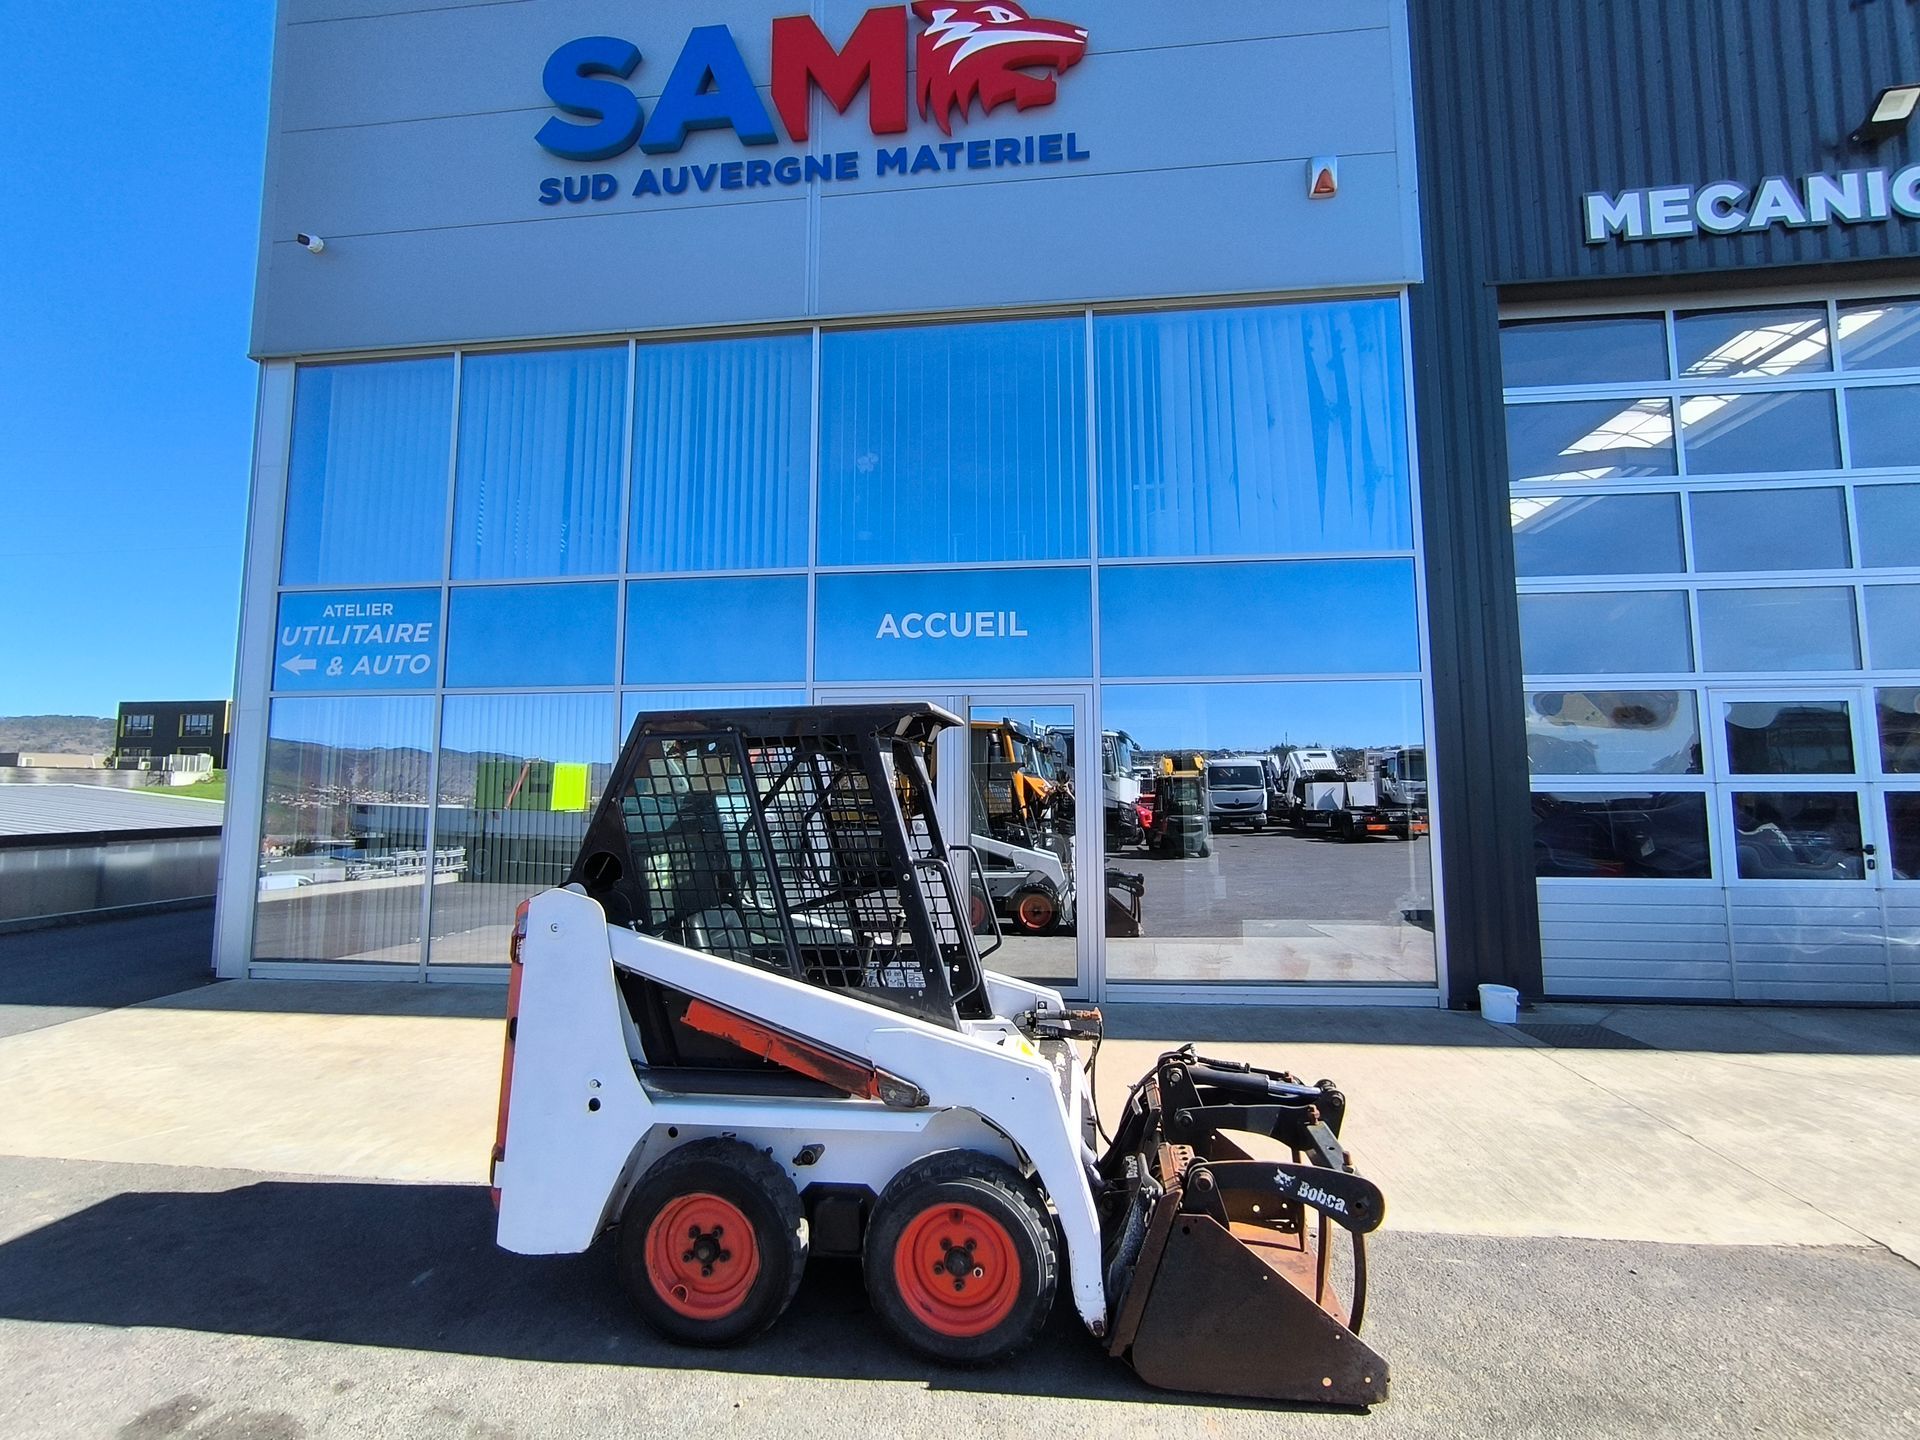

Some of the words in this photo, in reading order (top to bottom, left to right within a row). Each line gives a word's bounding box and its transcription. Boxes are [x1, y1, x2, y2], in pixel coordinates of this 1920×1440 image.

[534, 4, 907, 161] SAM
[539, 173, 618, 205] SUD
[632, 151, 859, 197] AUVERGNE
[877, 132, 1090, 176] MATERIEL
[322, 603, 394, 618] ATELIER
[281, 623, 433, 646] UTILITAIRE
[875, 611, 1029, 639] ACCUEIL
[325, 656, 344, 676] &
[350, 653, 432, 676] AUTO
[1297, 1180, 1349, 1216] Bobca
